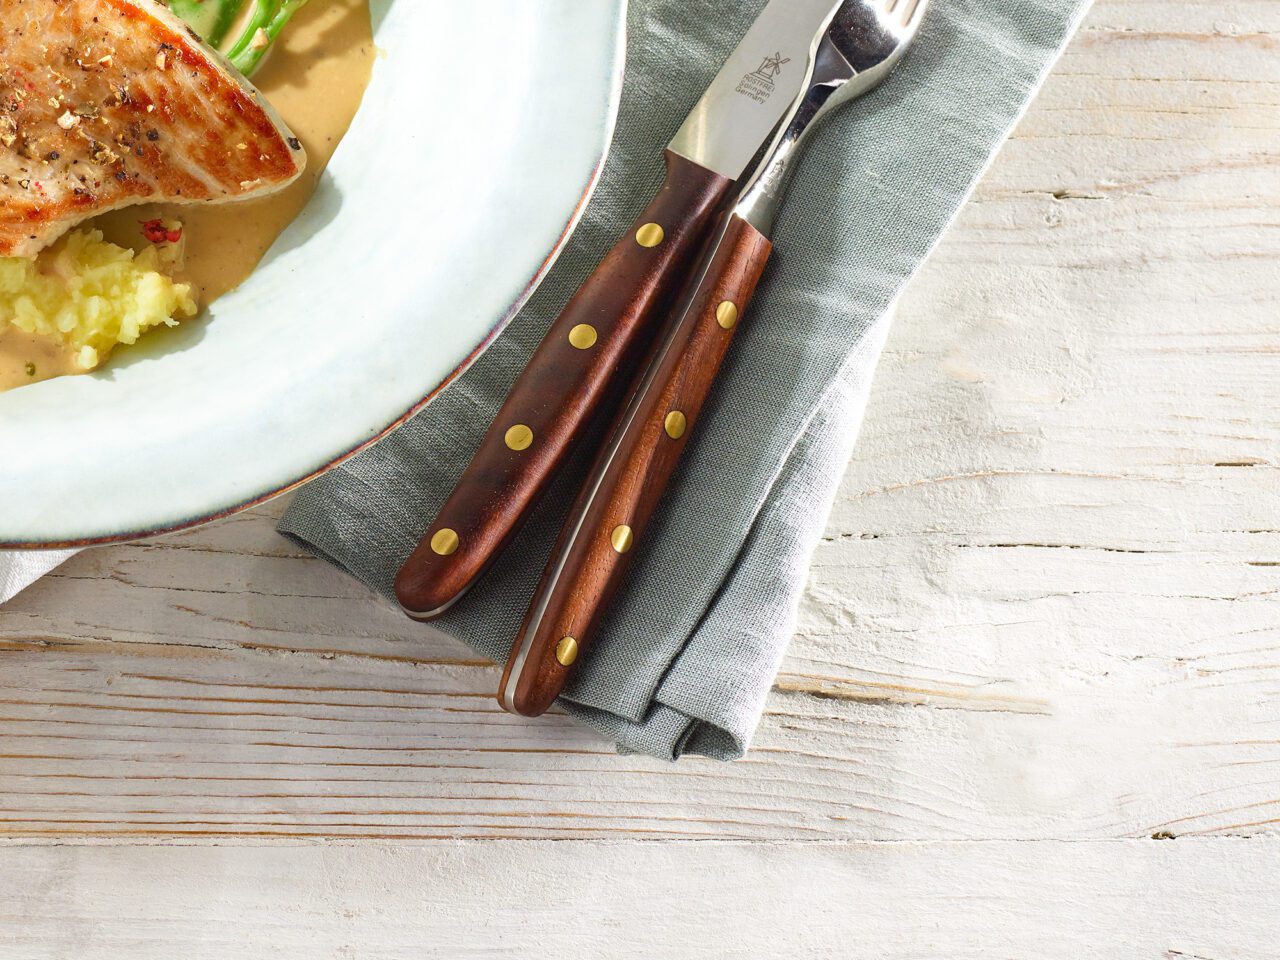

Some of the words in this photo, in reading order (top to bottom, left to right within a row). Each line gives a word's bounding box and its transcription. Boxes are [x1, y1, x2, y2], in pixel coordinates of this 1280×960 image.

[738, 80, 770, 99] Solingen
[743, 74, 775, 92] ROSTFREI
[735, 86, 766, 104] Germany
